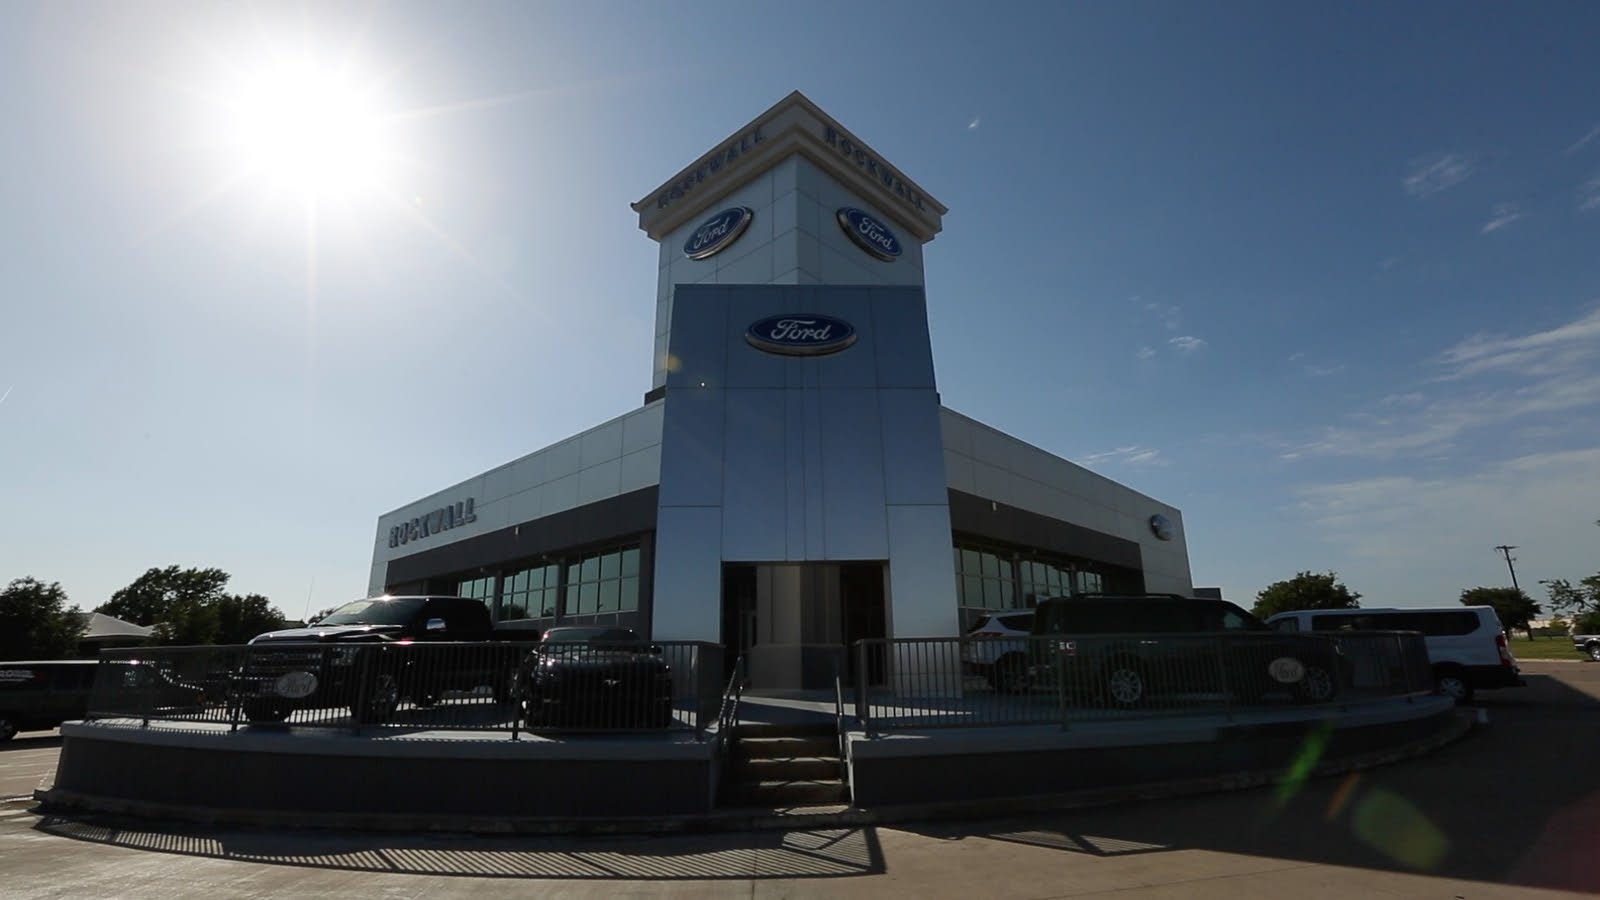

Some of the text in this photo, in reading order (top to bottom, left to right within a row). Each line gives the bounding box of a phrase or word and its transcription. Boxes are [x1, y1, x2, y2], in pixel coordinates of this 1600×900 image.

[824, 127, 926, 212] ROCKWALL
[693, 215, 730, 249] Ford
[859, 216, 893, 250] Ford
[770, 319, 832, 340] Ford
[389, 497, 477, 549] ROCKWALL
